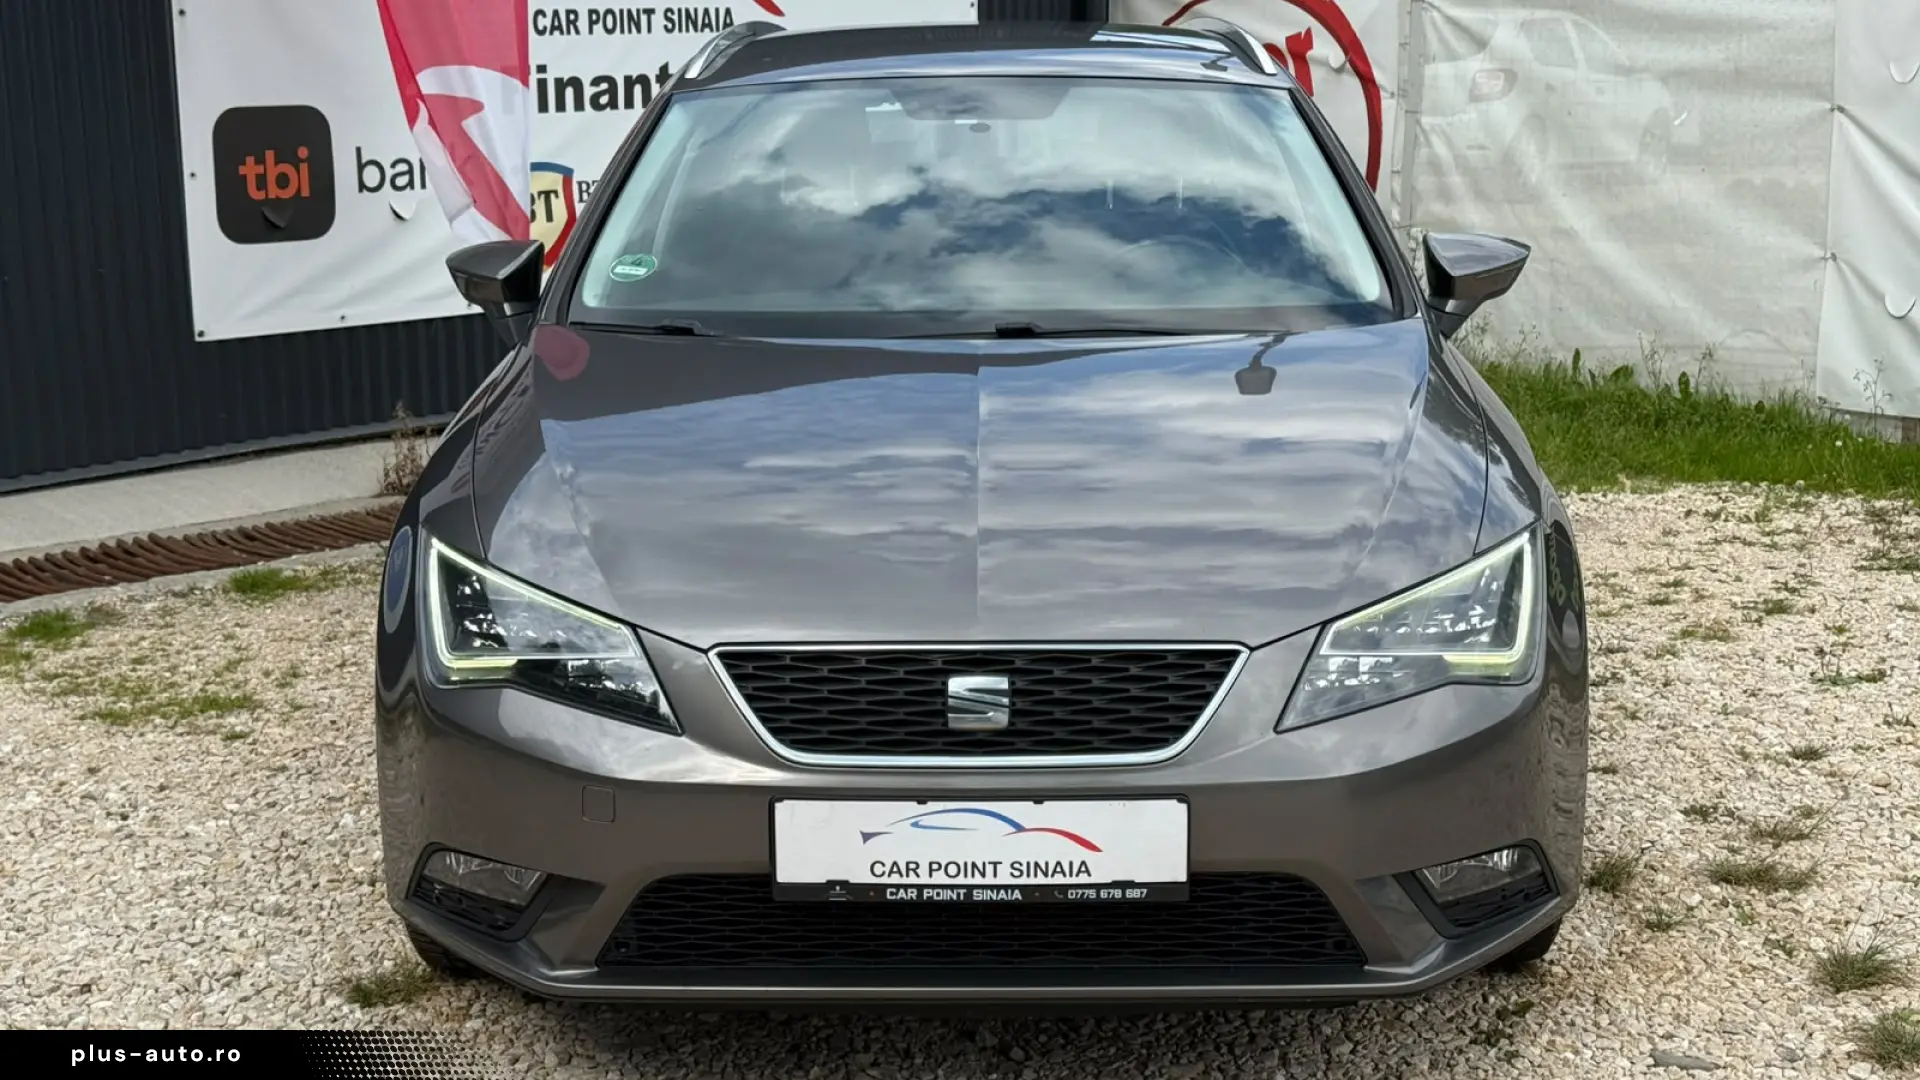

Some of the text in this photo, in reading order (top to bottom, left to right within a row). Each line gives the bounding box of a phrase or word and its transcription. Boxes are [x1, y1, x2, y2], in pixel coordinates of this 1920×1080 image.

[532, 7, 734, 36] CAR POINT SINAIA
[238, 146, 310, 200] tbi
[576, 180, 600, 203] B
[869, 859, 1092, 879] CAR POINT SINAIA
[886, 888, 1148, 901] CAR POINT SINAIA 0775 678 687
